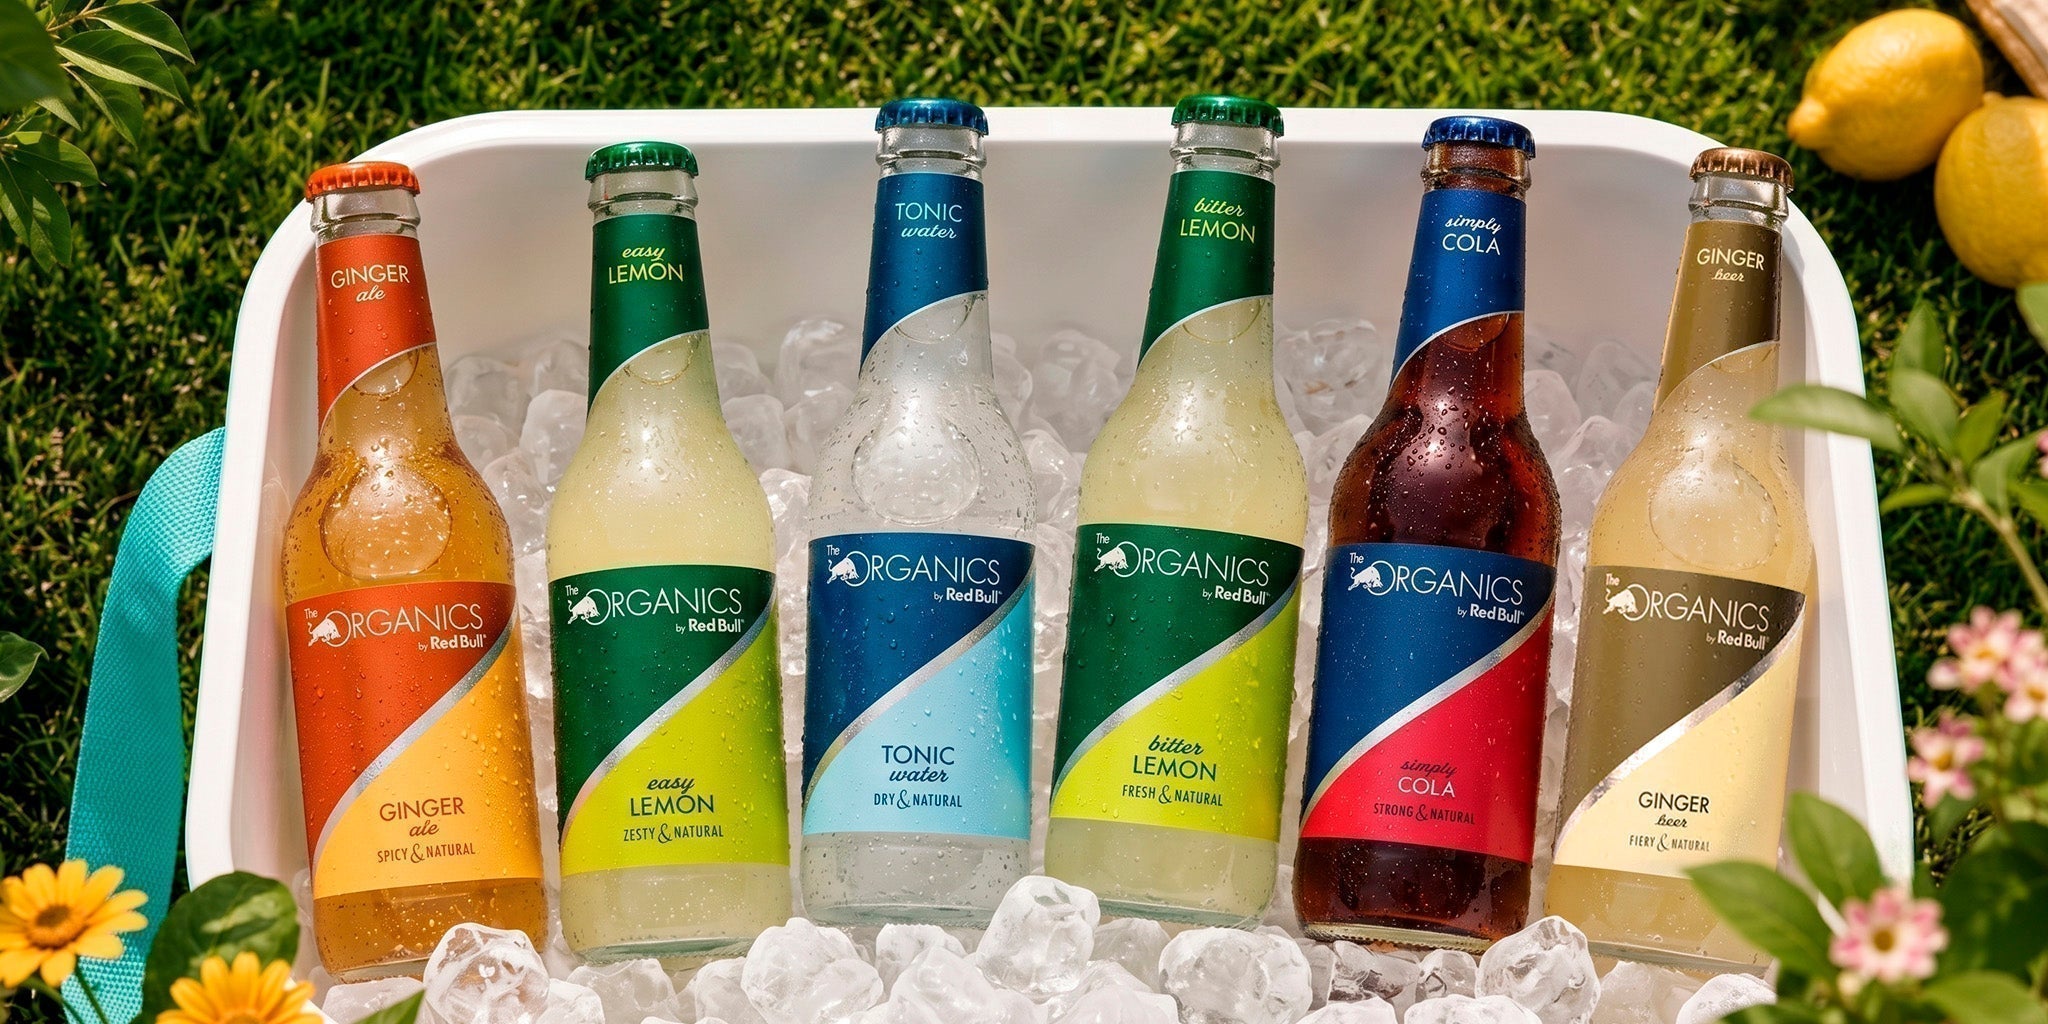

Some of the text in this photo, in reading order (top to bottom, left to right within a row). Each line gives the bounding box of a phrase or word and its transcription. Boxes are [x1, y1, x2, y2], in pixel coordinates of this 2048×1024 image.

[895, 202, 962, 222] TONIC
[1194, 198, 1244, 217] bitter
[901, 224, 957, 238] water
[1180, 218, 1255, 243] LEMON
[1445, 215, 1502, 235] simply
[1442, 233, 1500, 255] COLA
[622, 246, 665, 261] easy
[1697, 248, 1765, 270] GINGER
[331, 264, 410, 288] GINGER
[608, 262, 683, 284] LEMON
[1712, 268, 1745, 282] beer
[356, 285, 385, 302] ale
[1096, 533, 1110, 544] The
[826, 545, 840, 556] The
[1350, 553, 1364, 564] The
[1605, 574, 1620, 586] The
[565, 585, 579, 596] The
[934, 591, 943, 603] by
[946, 587, 973, 602] Red
[1202, 588, 1213, 600] by
[1214, 586, 1241, 602] Red
[304, 608, 318, 619] The
[1457, 606, 1467, 617] by
[1470, 604, 1496, 620] Red
[676, 623, 686, 635] by
[688, 618, 716, 632] Red
[418, 641, 428, 652] by
[430, 636, 458, 650] Red
[1706, 633, 1716, 644] by
[1717, 630, 1742, 646] Red
[1148, 734, 1204, 755] bitter
[881, 745, 955, 765] TONIC
[889, 767, 949, 783] water
[1133, 755, 1217, 782] LEMON
[1400, 760, 1457, 778] simply
[646, 776, 695, 794] easy
[1398, 776, 1456, 798] COLA
[874, 793, 895, 806] DRY
[913, 794, 962, 808] NATURAL
[1122, 784, 1156, 799] FRESH
[1174, 789, 1223, 807] NATURAL
[1638, 791, 1710, 814] GINGER
[379, 796, 465, 822] GINGER
[630, 794, 714, 817] LEMON
[1373, 802, 1414, 818] STRONG
[1430, 808, 1475, 824] NATURAL
[409, 820, 440, 838] ale
[1654, 814, 1688, 828] beer
[623, 827, 655, 842] ZESTY
[674, 824, 724, 839] NATURAL
[1629, 834, 1656, 848] FIERY
[1671, 838, 1710, 852] NATURAL
[377, 847, 408, 864] SPICY
[426, 842, 476, 858] NATURAL
